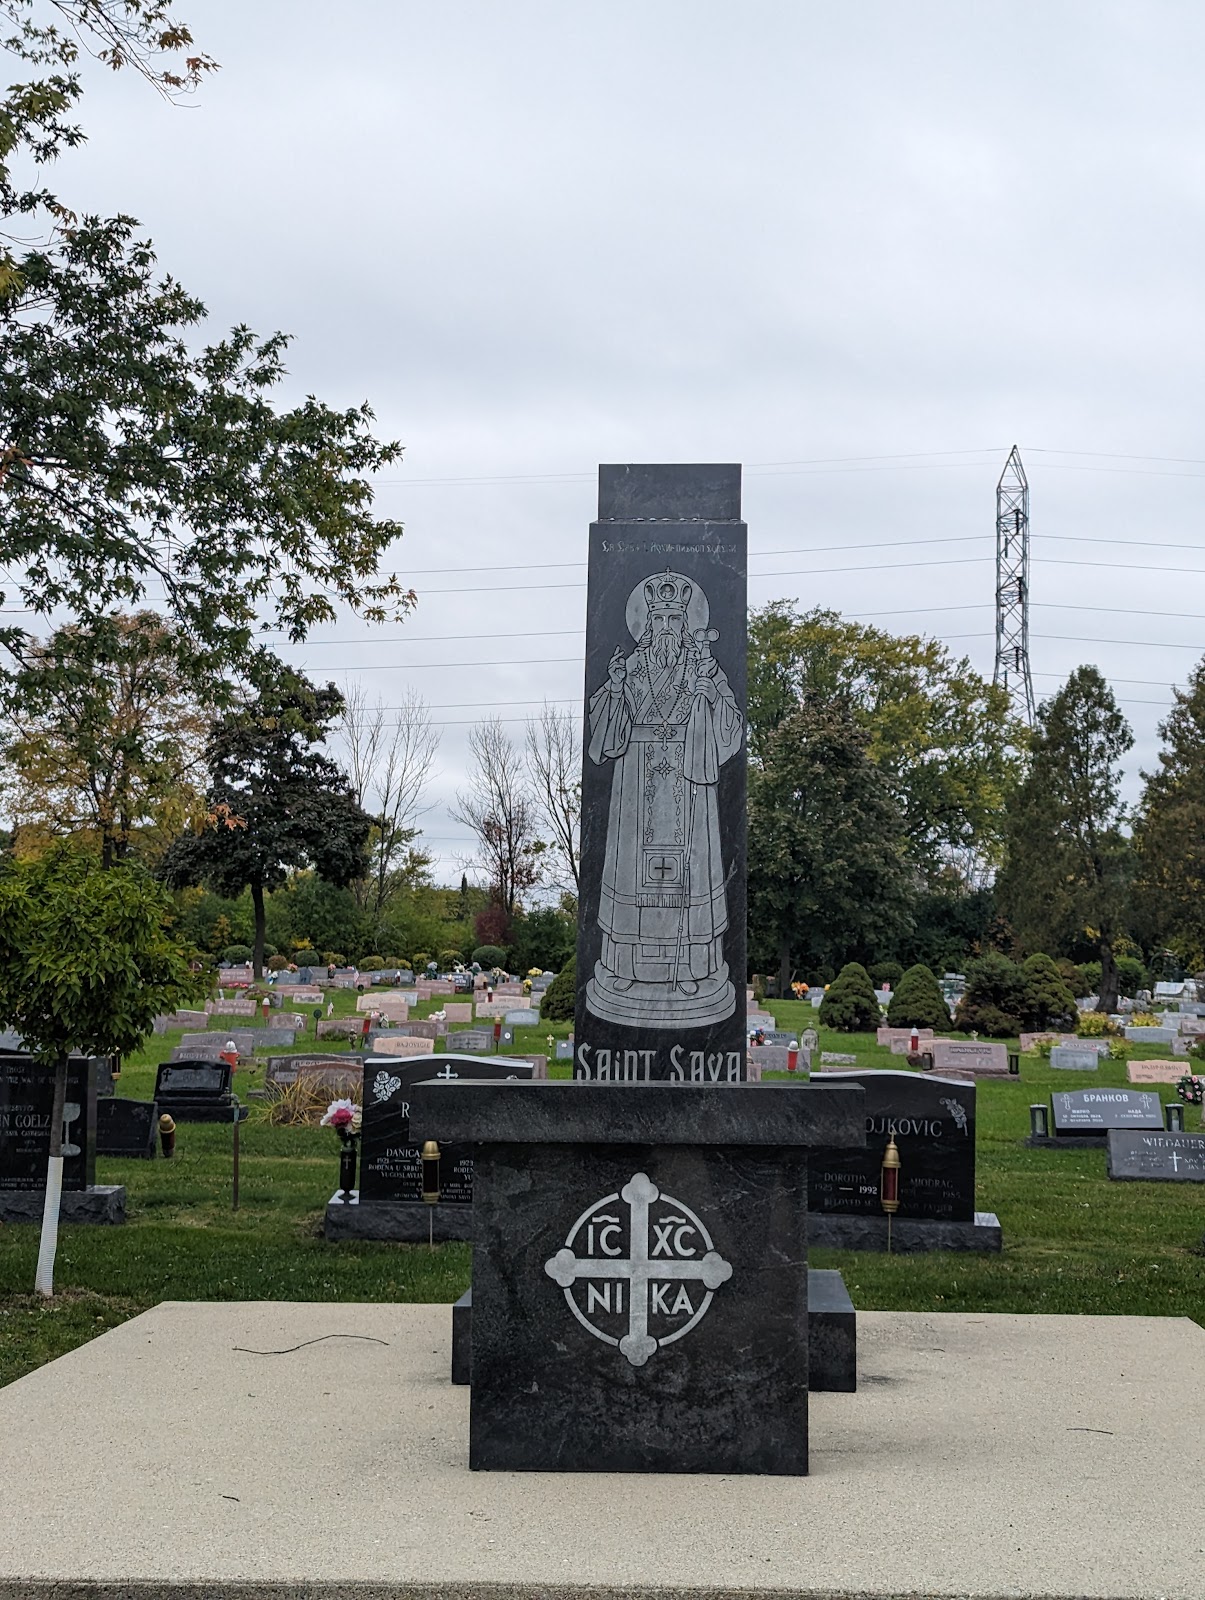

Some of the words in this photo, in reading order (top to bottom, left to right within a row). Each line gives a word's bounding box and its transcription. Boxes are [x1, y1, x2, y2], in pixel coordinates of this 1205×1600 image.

[1083, 1093, 1129, 1103] БРАНКОВ
[865, 1116, 943, 1138] OJKOVIC
[386, 1148, 421, 1158] DANICA
[824, 1172, 868, 1183] DOROTHY
[859, 1185, 878, 1195] 1992
[588, 1282, 623, 1314] NI
[652, 1282, 695, 1315] KA
